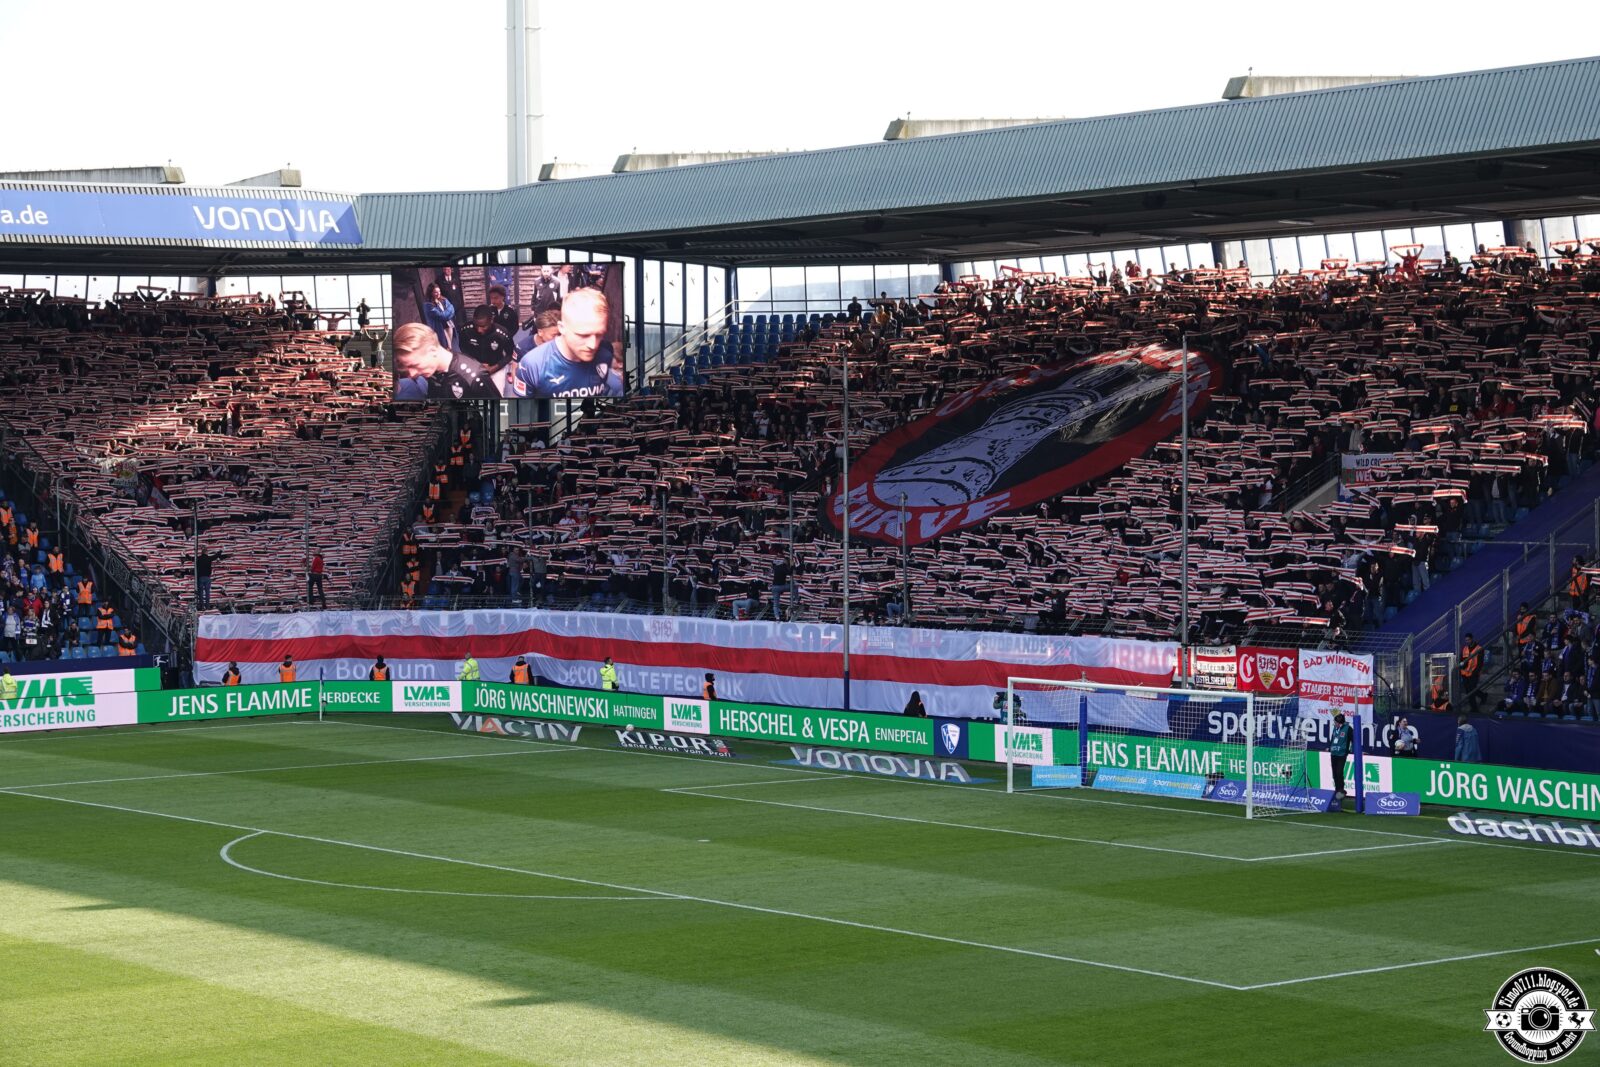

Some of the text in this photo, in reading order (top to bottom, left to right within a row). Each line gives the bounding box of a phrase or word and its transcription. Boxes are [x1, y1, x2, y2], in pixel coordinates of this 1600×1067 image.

[1303, 654, 1370, 675] BAD WIMPFEN
[403, 685, 435, 700] LVM
[1300, 683, 1331, 695] STAUFER
[168, 688, 380, 716] JENS FLAMME HERDECKE
[474, 683, 657, 721] JÖRG WASCHNEWSKI HATTINGEN
[671, 703, 692, 720] LVM
[450, 712, 583, 743] VIACTIV
[671, 719, 703, 729] VERSICHERUNG
[719, 708, 928, 746] HERSCHEL & VESPA ENNEPETAL
[615, 729, 713, 751] KIPOR
[1136, 744, 1222, 775] FLAMME
[1230, 759, 1293, 778] HEDECKE
[1220, 786, 1237, 796] Seco
[1426, 763, 1488, 800] JÖRG
[1309, 796, 1326, 806] Tor
[1380, 798, 1405, 807] Seco
